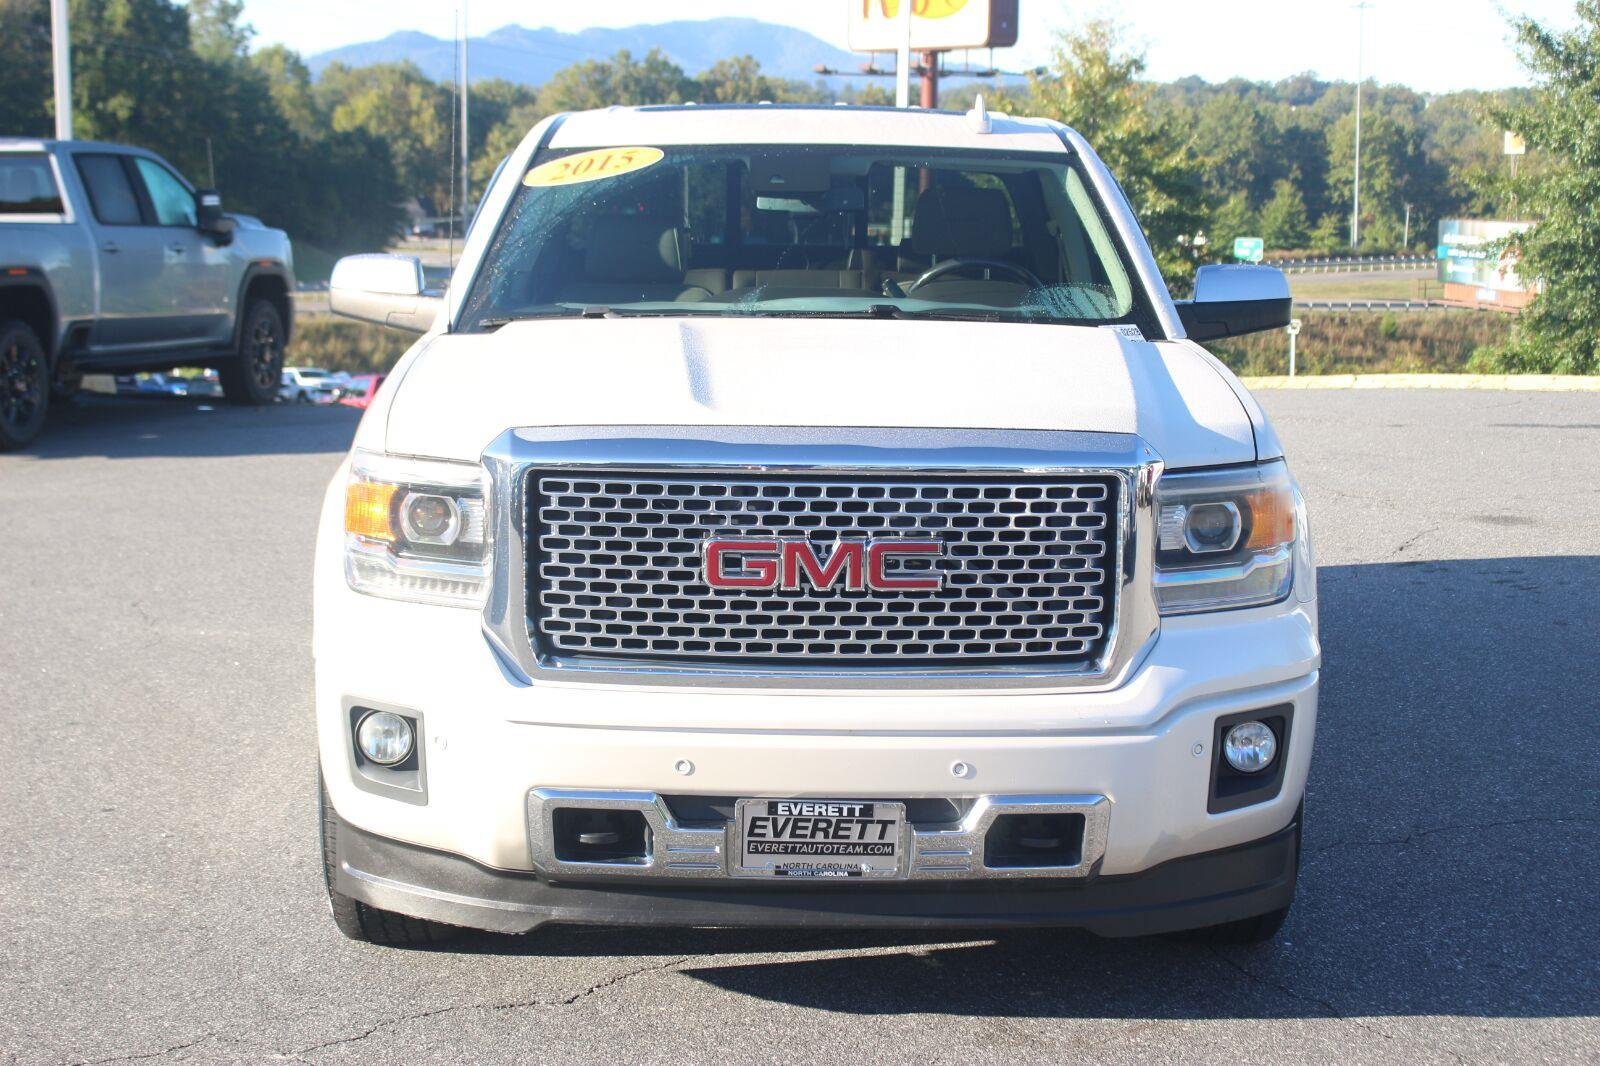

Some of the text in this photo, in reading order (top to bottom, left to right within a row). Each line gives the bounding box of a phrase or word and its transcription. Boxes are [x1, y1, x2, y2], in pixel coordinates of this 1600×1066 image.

[551, 150, 638, 181] 2015
[702, 536, 946, 591] GMC
[777, 802, 864, 817] EVERETT
[747, 816, 896, 841] EVERETT
[749, 842, 893, 855] EVERETTAUTOTEAM.COM
[782, 862, 814, 870] NORTH
[813, 870, 849, 878] CAROLINA
